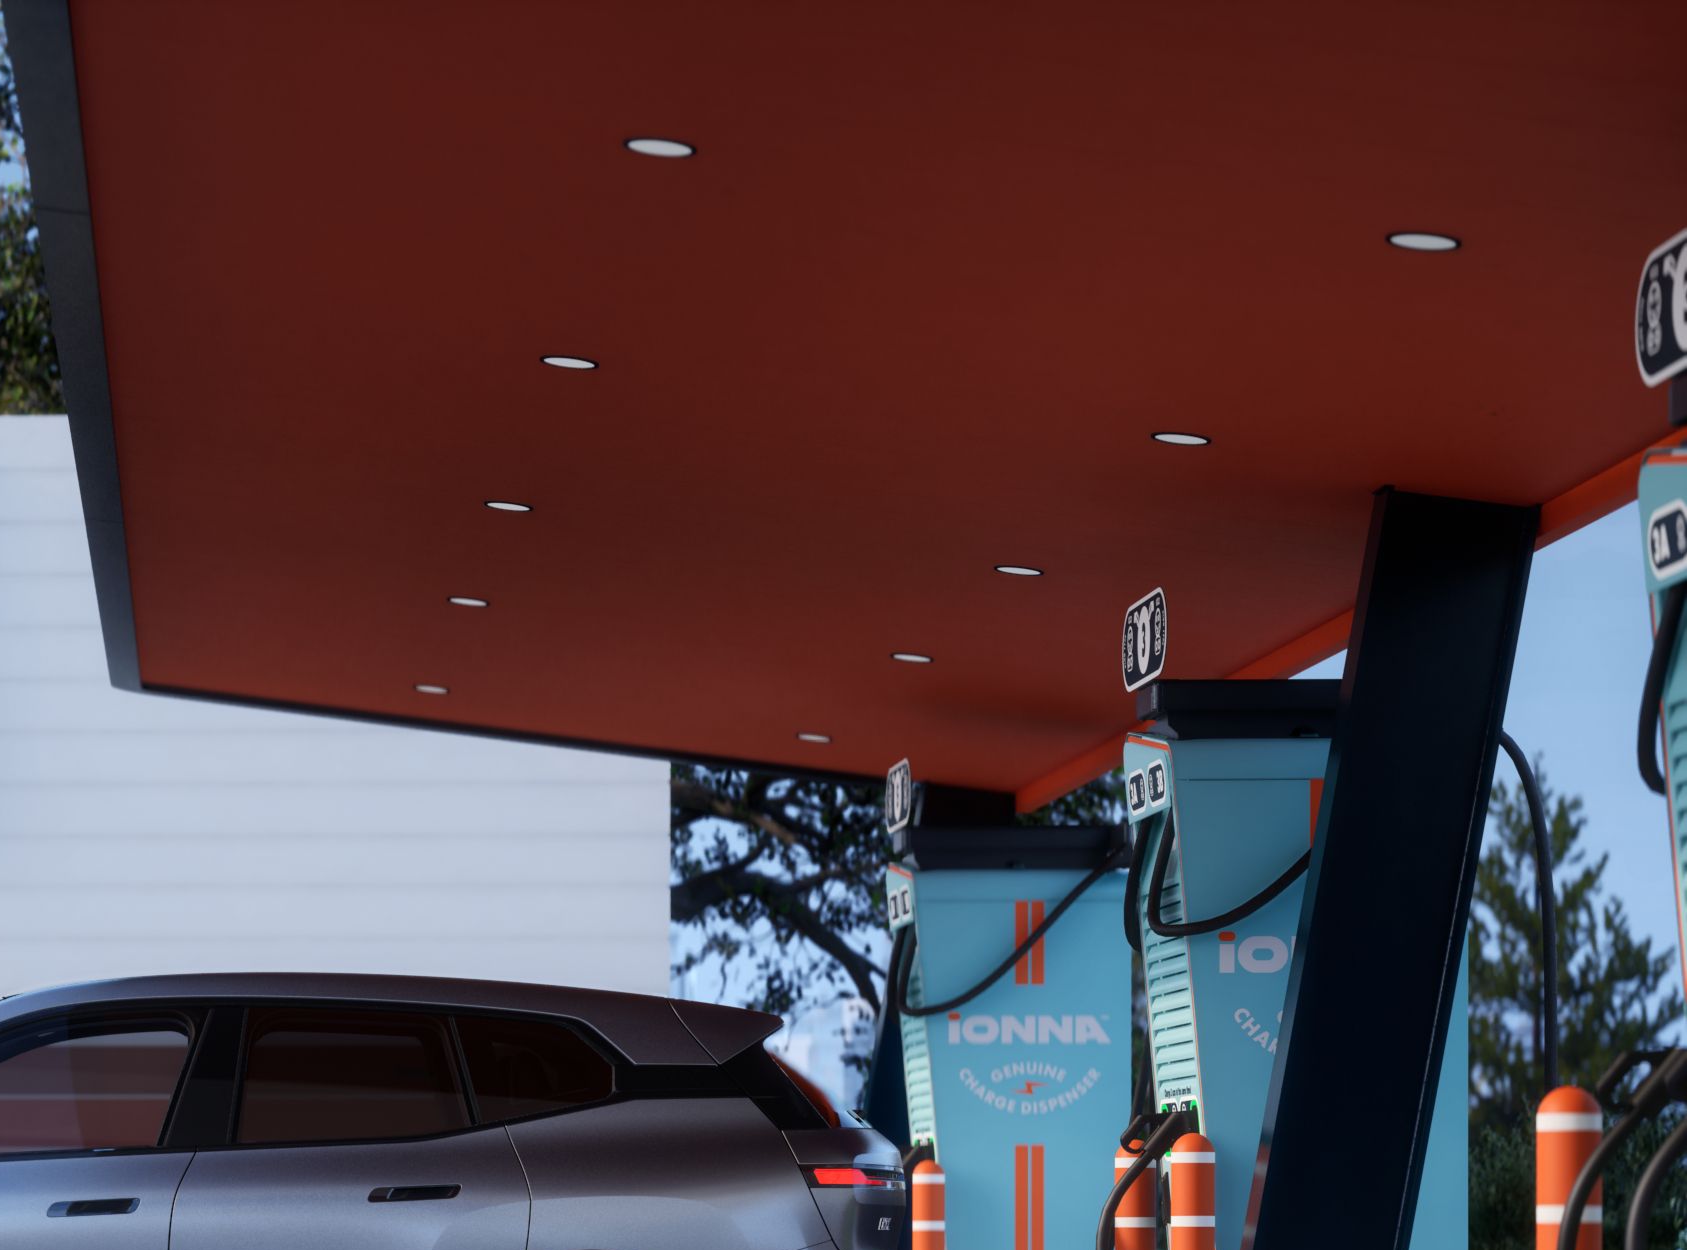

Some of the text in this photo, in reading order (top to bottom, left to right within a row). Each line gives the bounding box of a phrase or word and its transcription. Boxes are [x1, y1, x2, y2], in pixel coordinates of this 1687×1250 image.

[1218, 931, 1296, 973] iO
[959, 1067, 1101, 1116] CHARGE DISPENSER
[991, 1061, 1067, 1083] GENUINE
